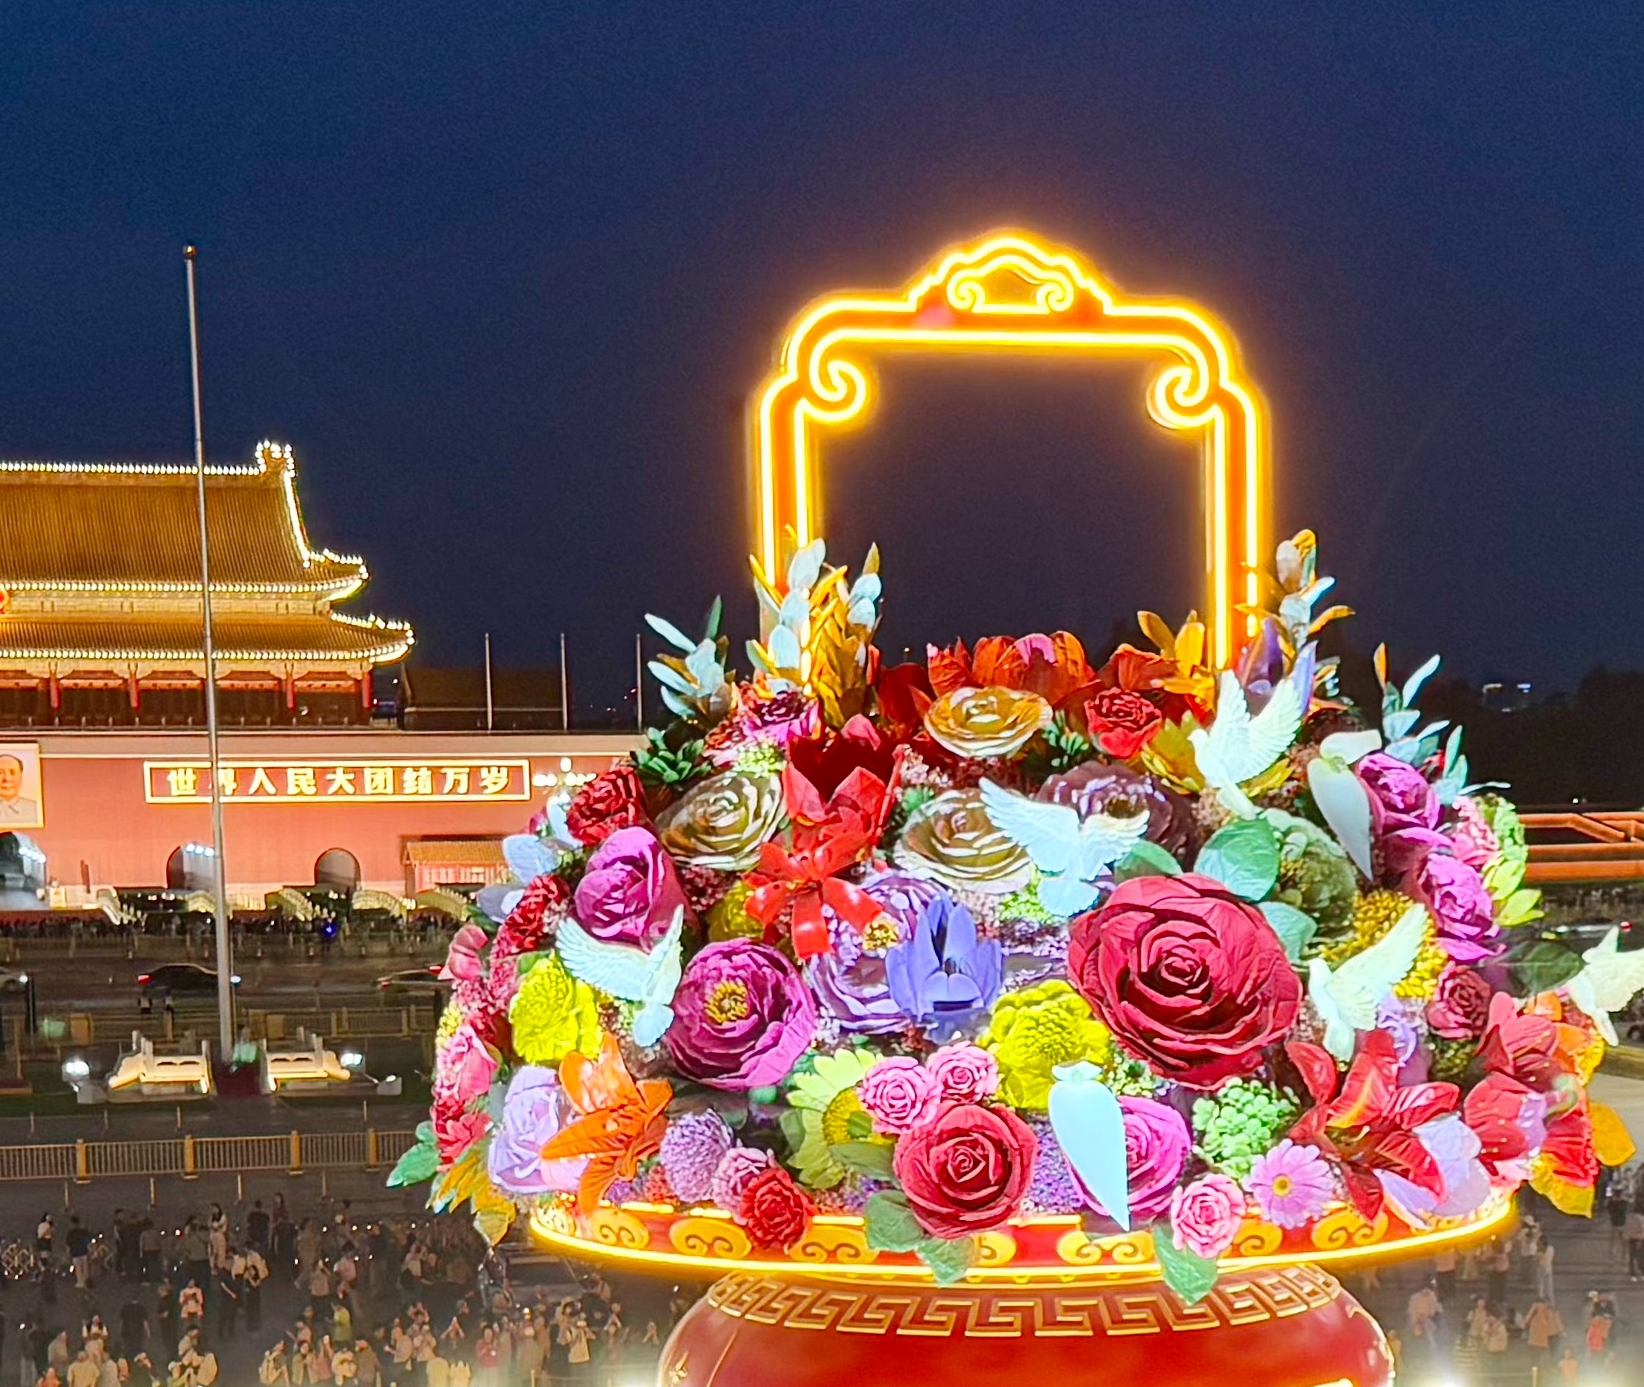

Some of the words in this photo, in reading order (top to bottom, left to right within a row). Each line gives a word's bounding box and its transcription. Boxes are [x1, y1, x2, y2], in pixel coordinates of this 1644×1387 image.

[166, 766, 510, 796] 世界人民大团结万岁
